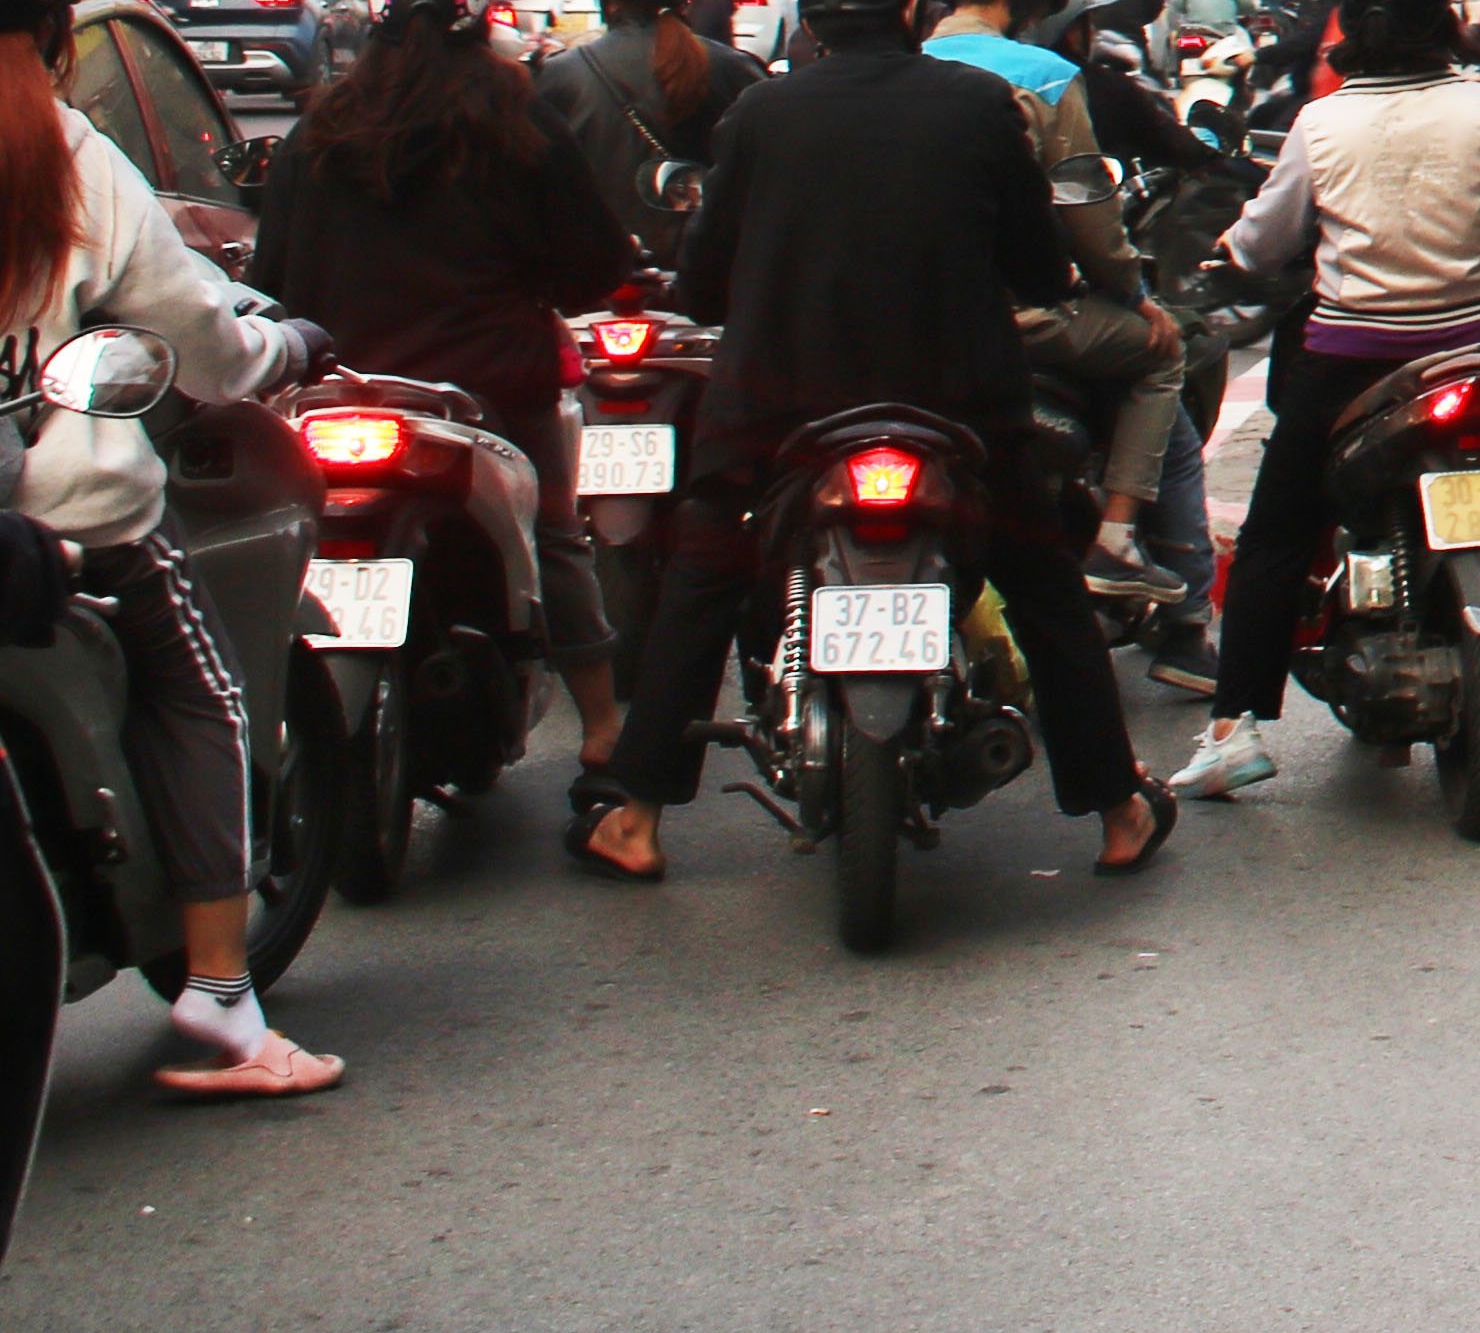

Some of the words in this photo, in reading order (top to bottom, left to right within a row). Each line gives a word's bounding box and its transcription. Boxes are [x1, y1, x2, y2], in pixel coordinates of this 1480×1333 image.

[586, 431, 658, 459] 29-S6
[835, 592, 929, 627] 37-B2
[822, 630, 939, 665] 672.46
